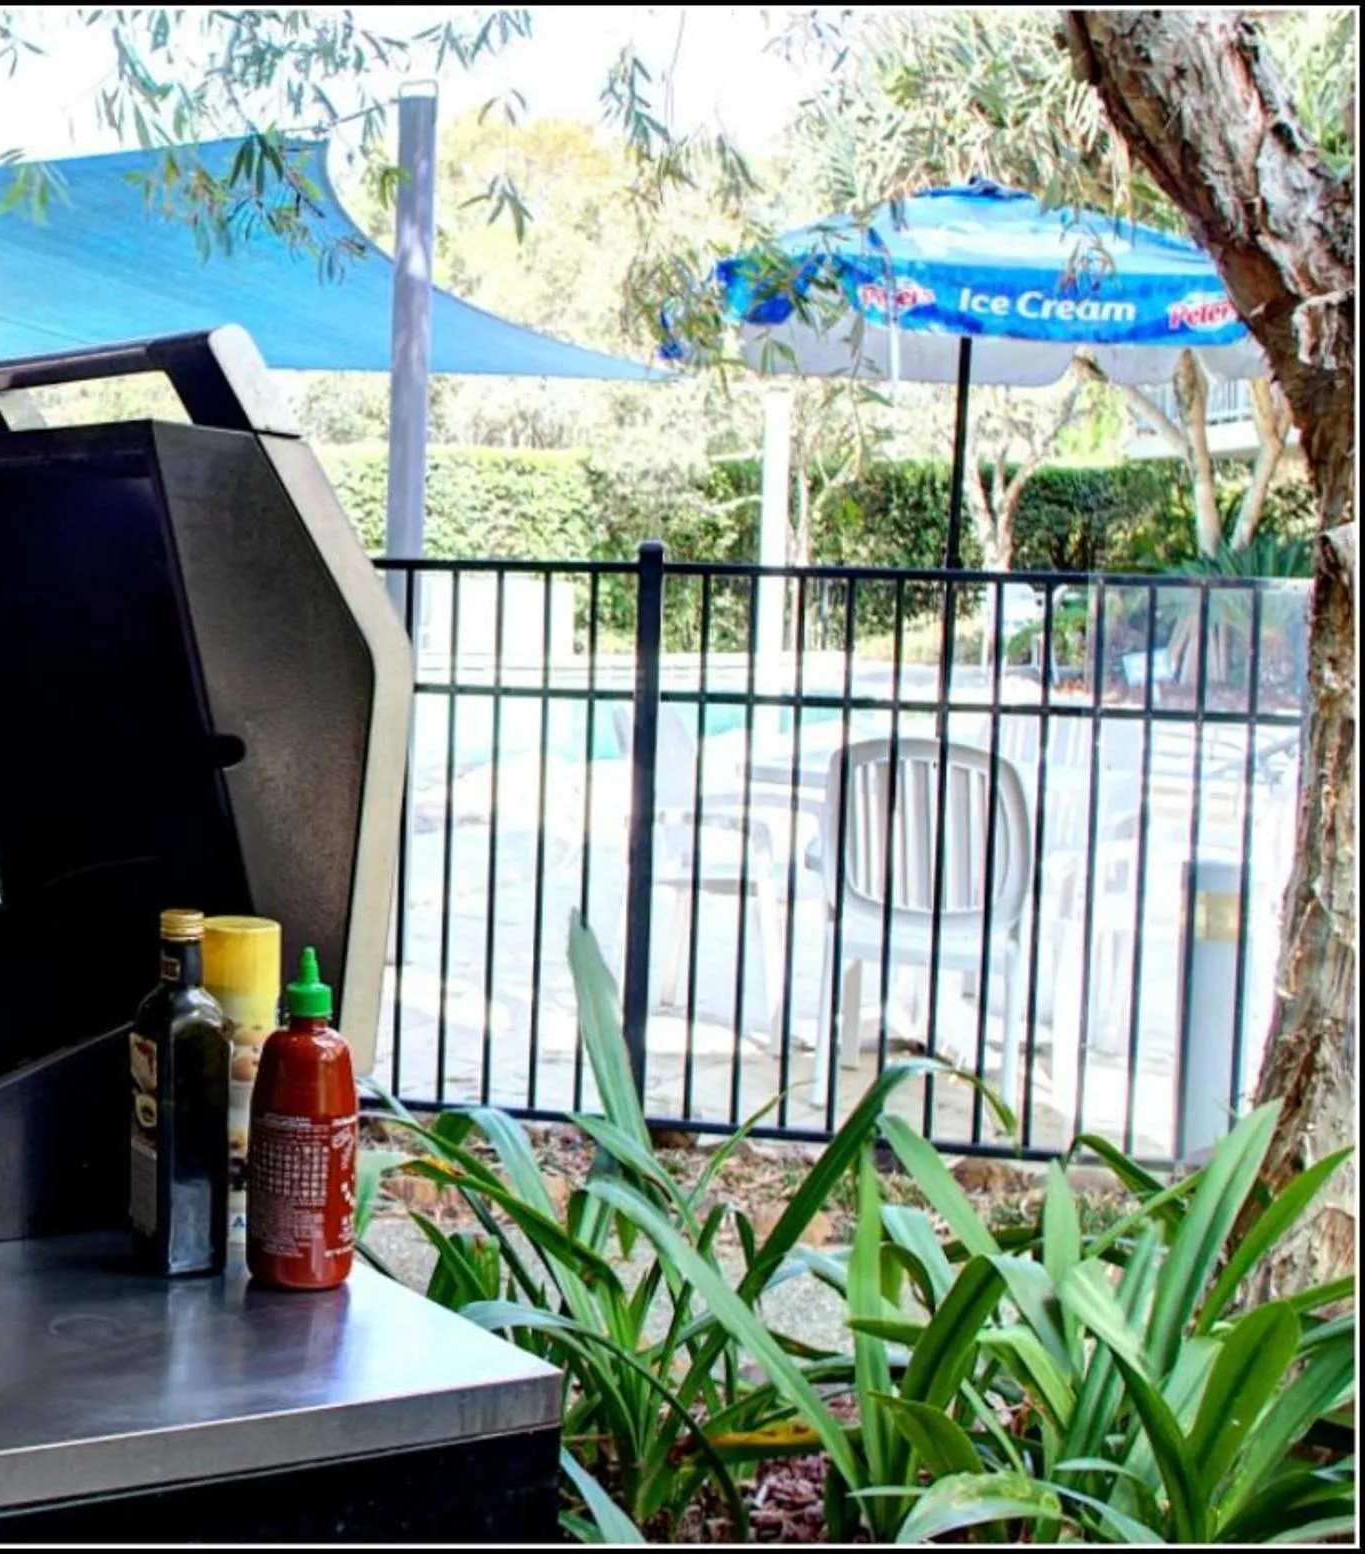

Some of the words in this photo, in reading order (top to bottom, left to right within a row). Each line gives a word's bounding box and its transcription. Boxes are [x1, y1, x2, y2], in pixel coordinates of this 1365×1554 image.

[958, 287, 1010, 317] Ice
[1016, 290, 1137, 322] Cream
[1168, 301, 1238, 330] Peter
